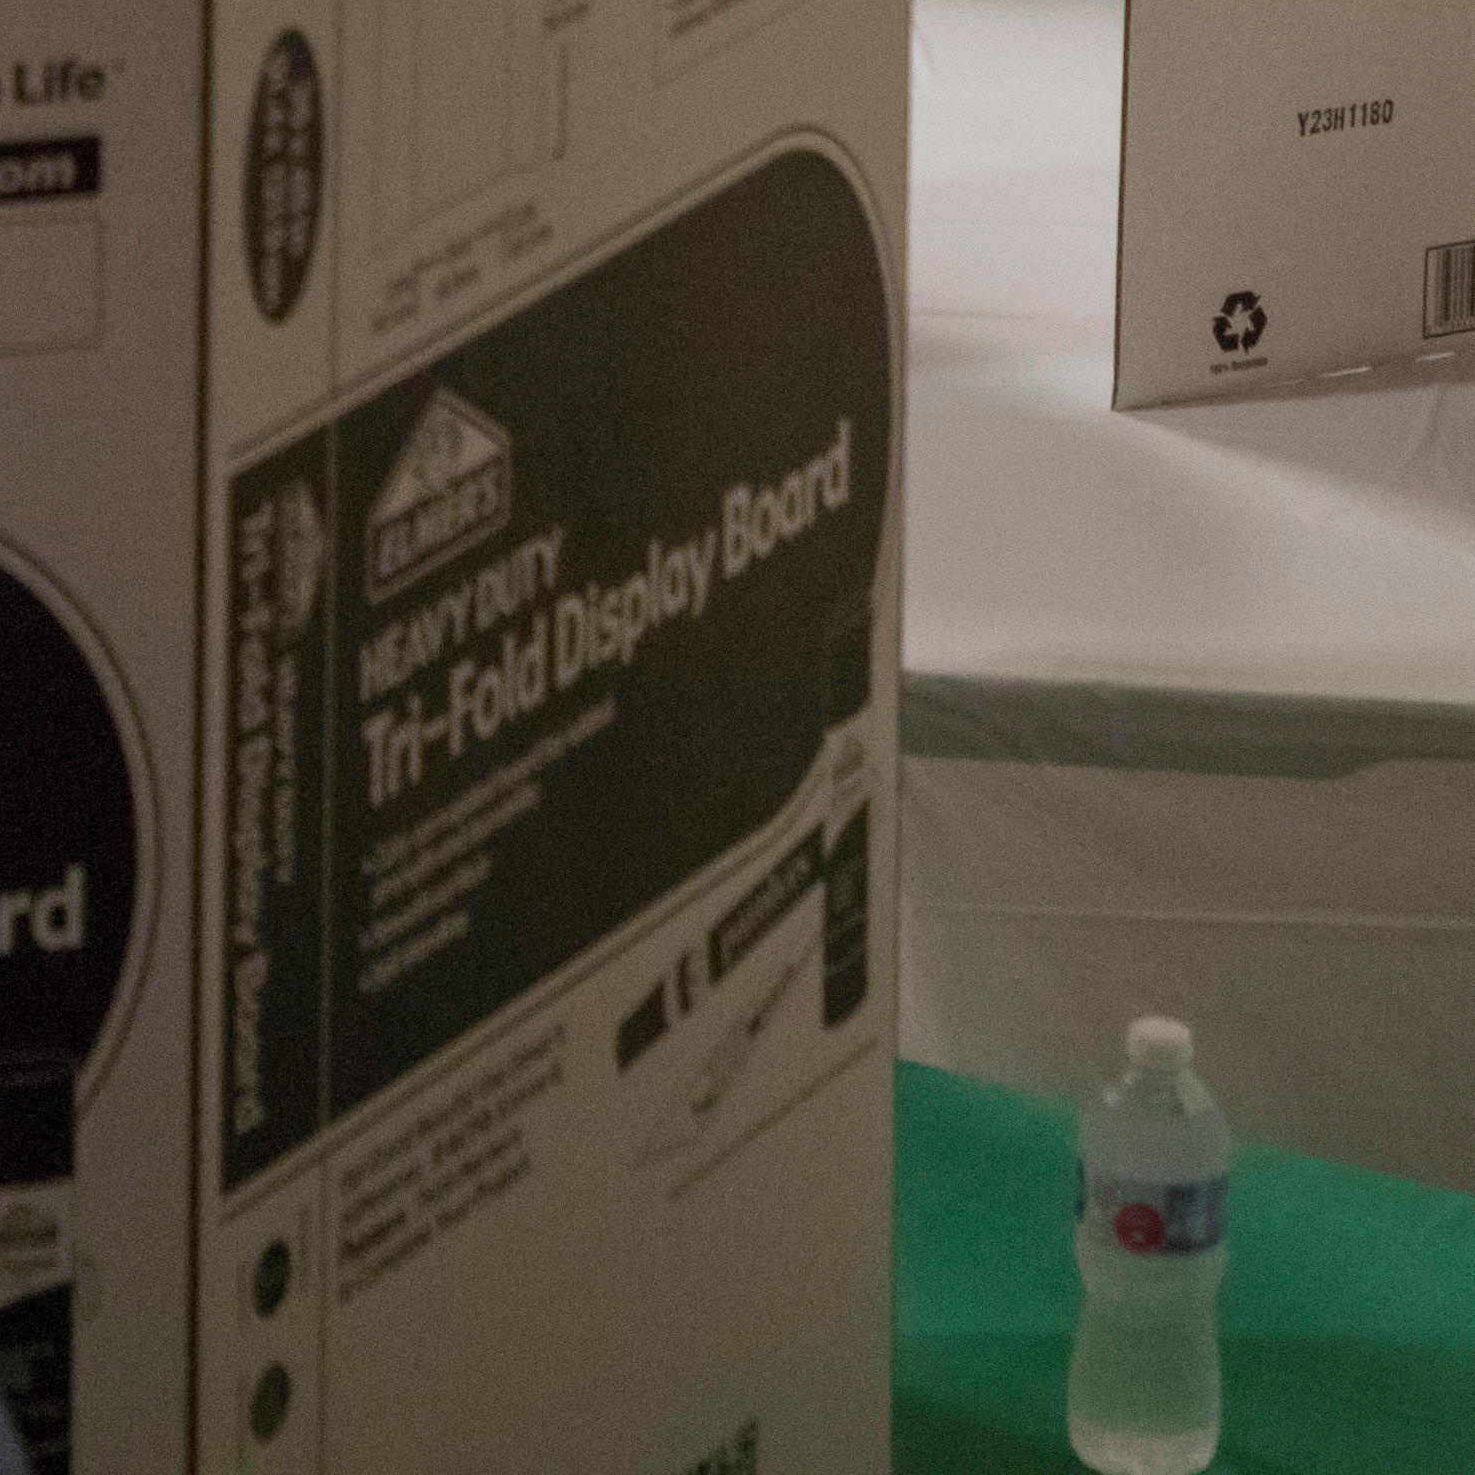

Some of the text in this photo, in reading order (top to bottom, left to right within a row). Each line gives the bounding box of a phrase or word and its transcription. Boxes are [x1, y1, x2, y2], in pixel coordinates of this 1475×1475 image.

[13, 56, 104, 103] Life
[1296, 98, 1394, 137] Y23H1180
[359, 527, 563, 703] HEAVY DUTY
[362, 627, 548, 811] Tri-Fold
[556, 532, 715, 692] Display
[722, 415, 853, 582] Board
